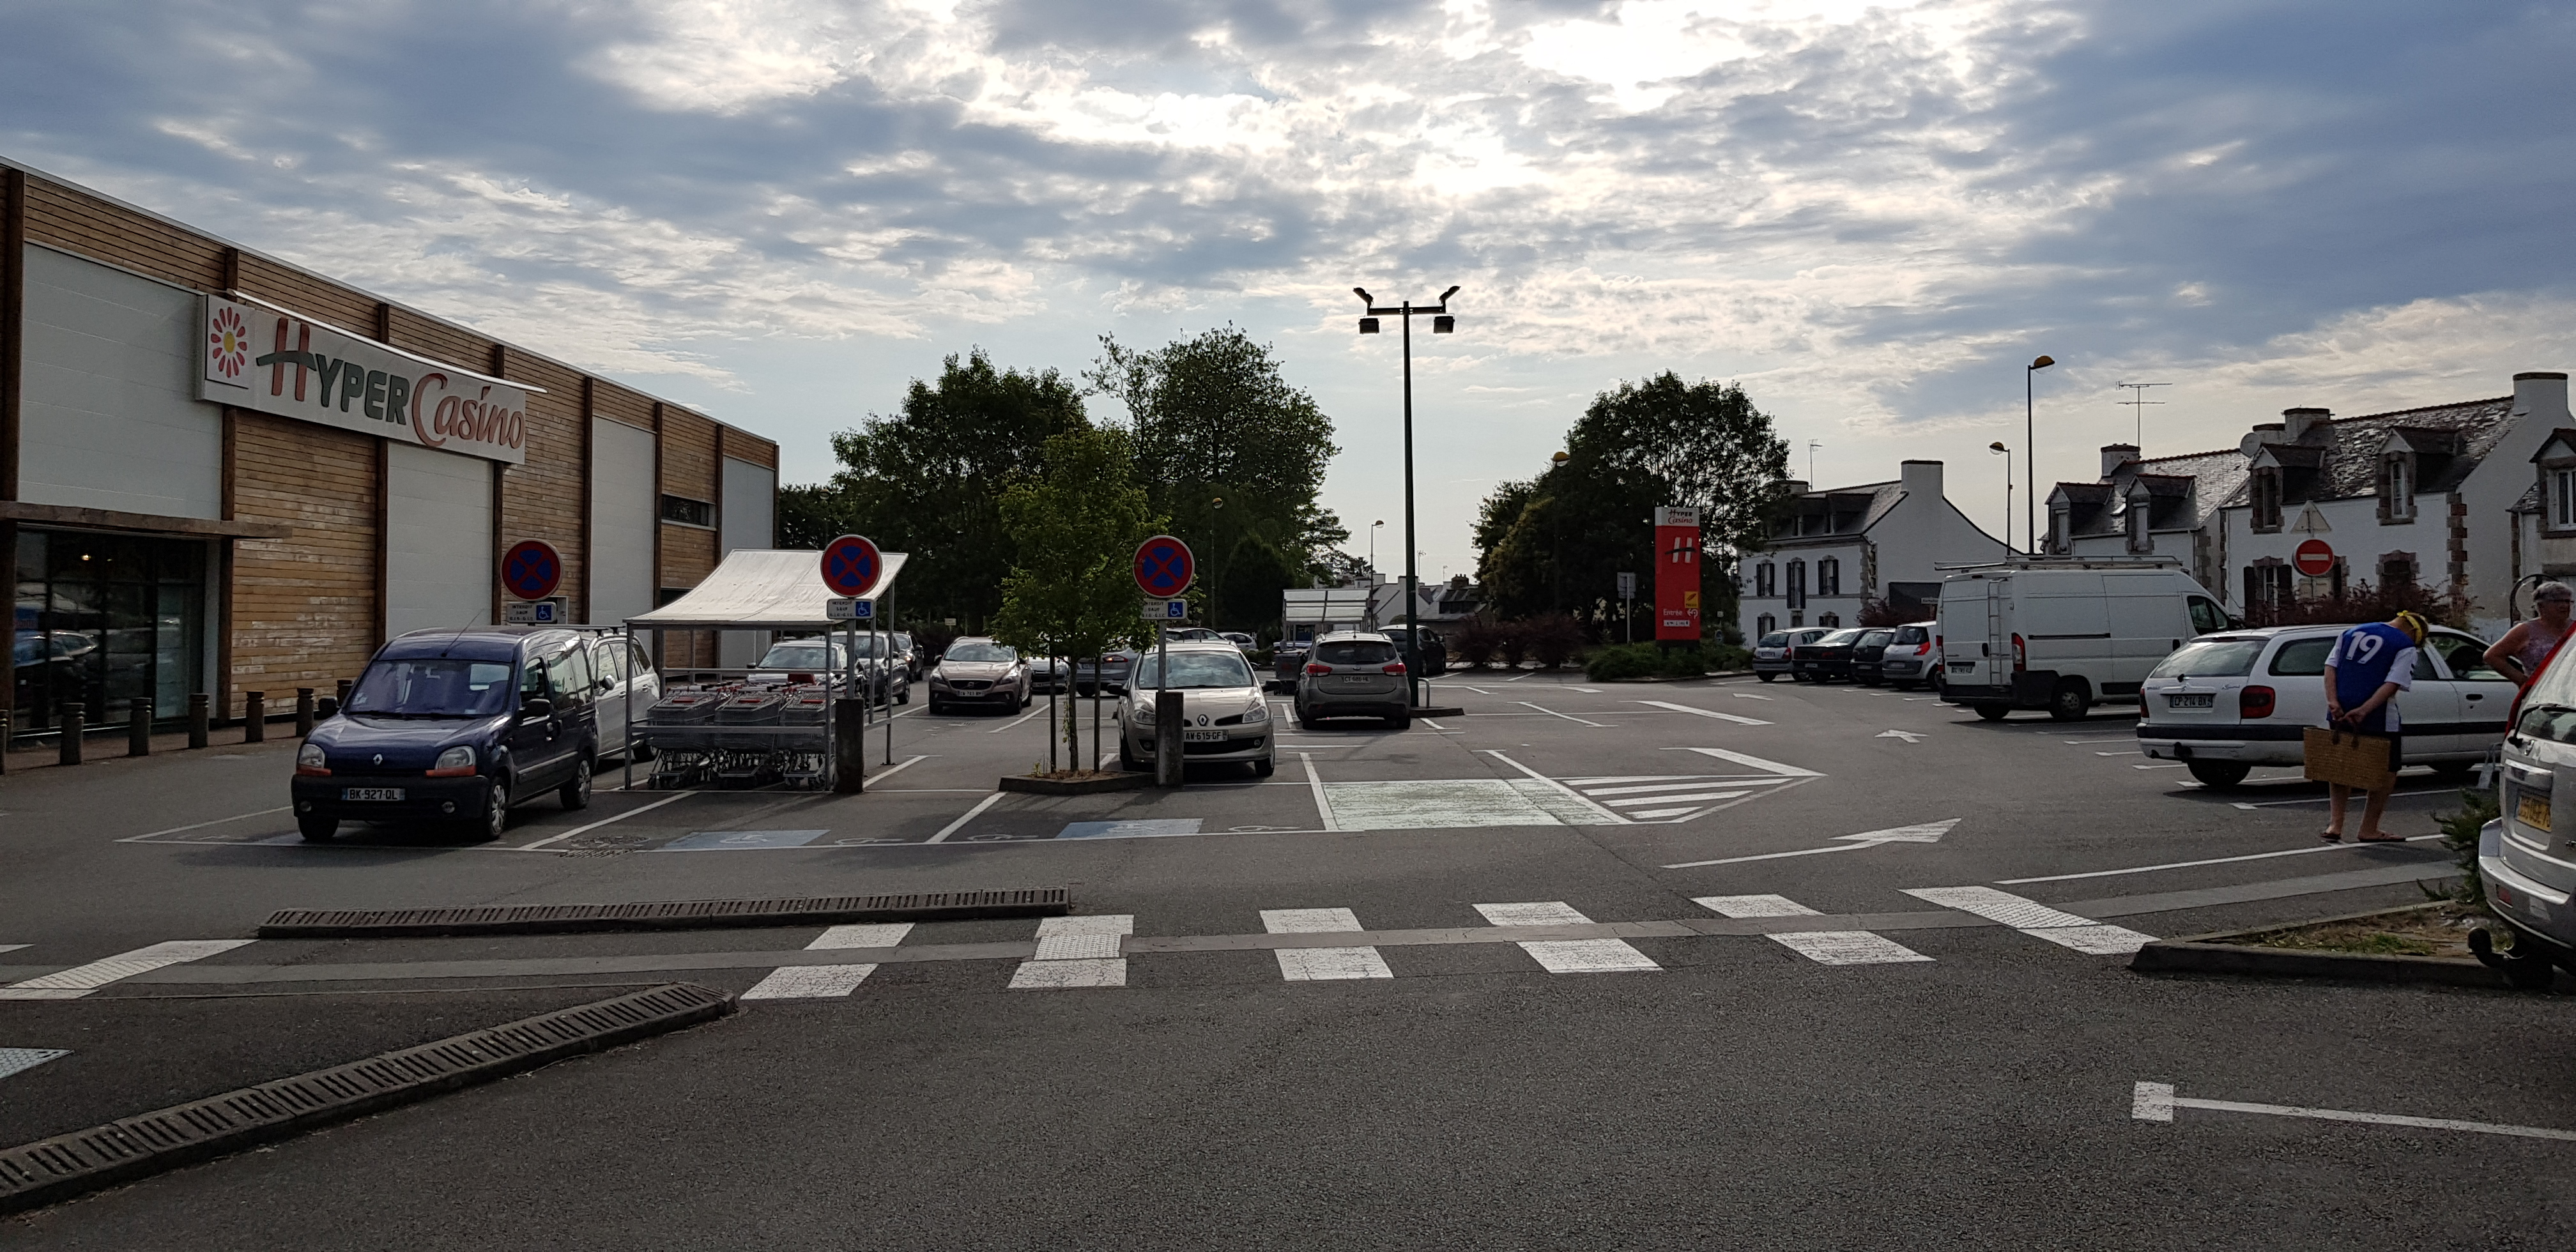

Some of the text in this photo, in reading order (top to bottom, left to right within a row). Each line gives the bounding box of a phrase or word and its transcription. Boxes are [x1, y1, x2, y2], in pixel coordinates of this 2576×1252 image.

[256, 317, 525, 449] HYPER Casino
[1667, 516, 1693, 524] Casino
[1663, 608, 1683, 616] Entrée
[2345, 631, 2384, 664] 19
